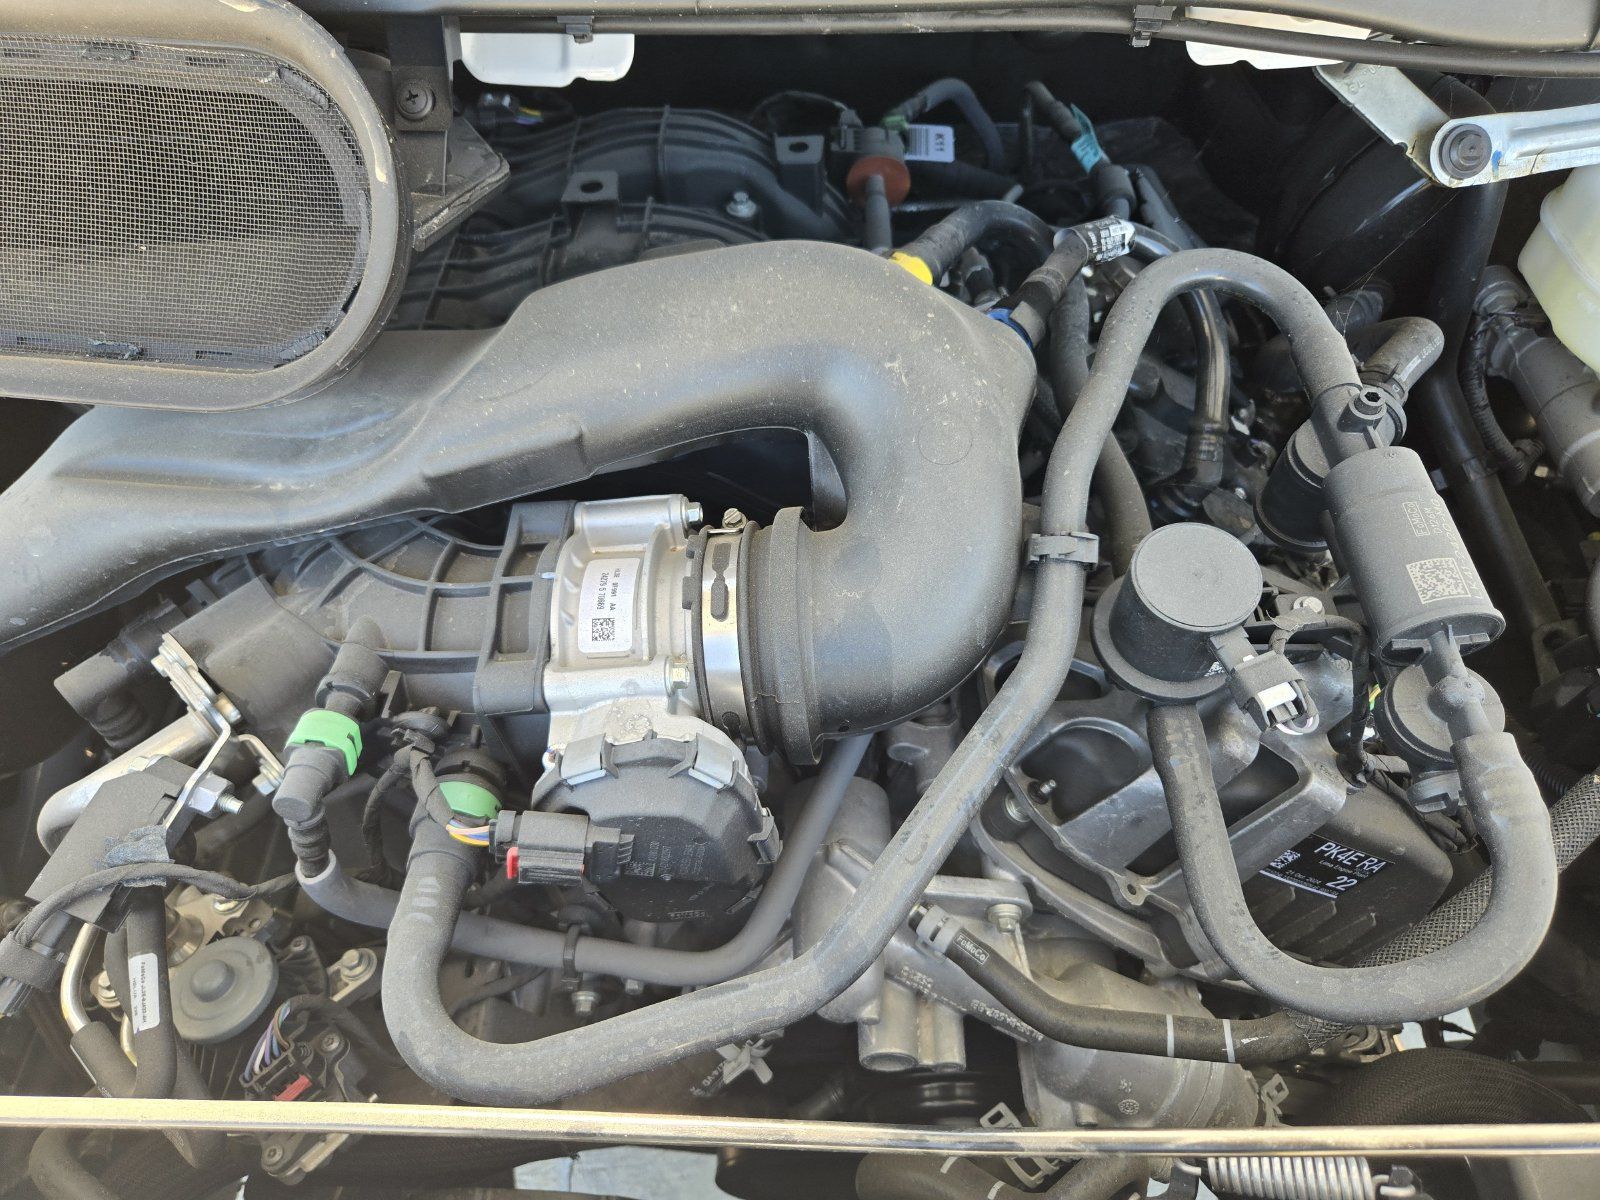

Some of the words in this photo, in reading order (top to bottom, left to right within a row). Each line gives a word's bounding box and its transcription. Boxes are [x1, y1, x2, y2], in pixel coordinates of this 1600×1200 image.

[1314, 841, 1365, 866] PK4E
[1356, 857, 1387, 873] RA
[1326, 875, 1358, 891] 22
[956, 934, 986, 961] FoMoCo
